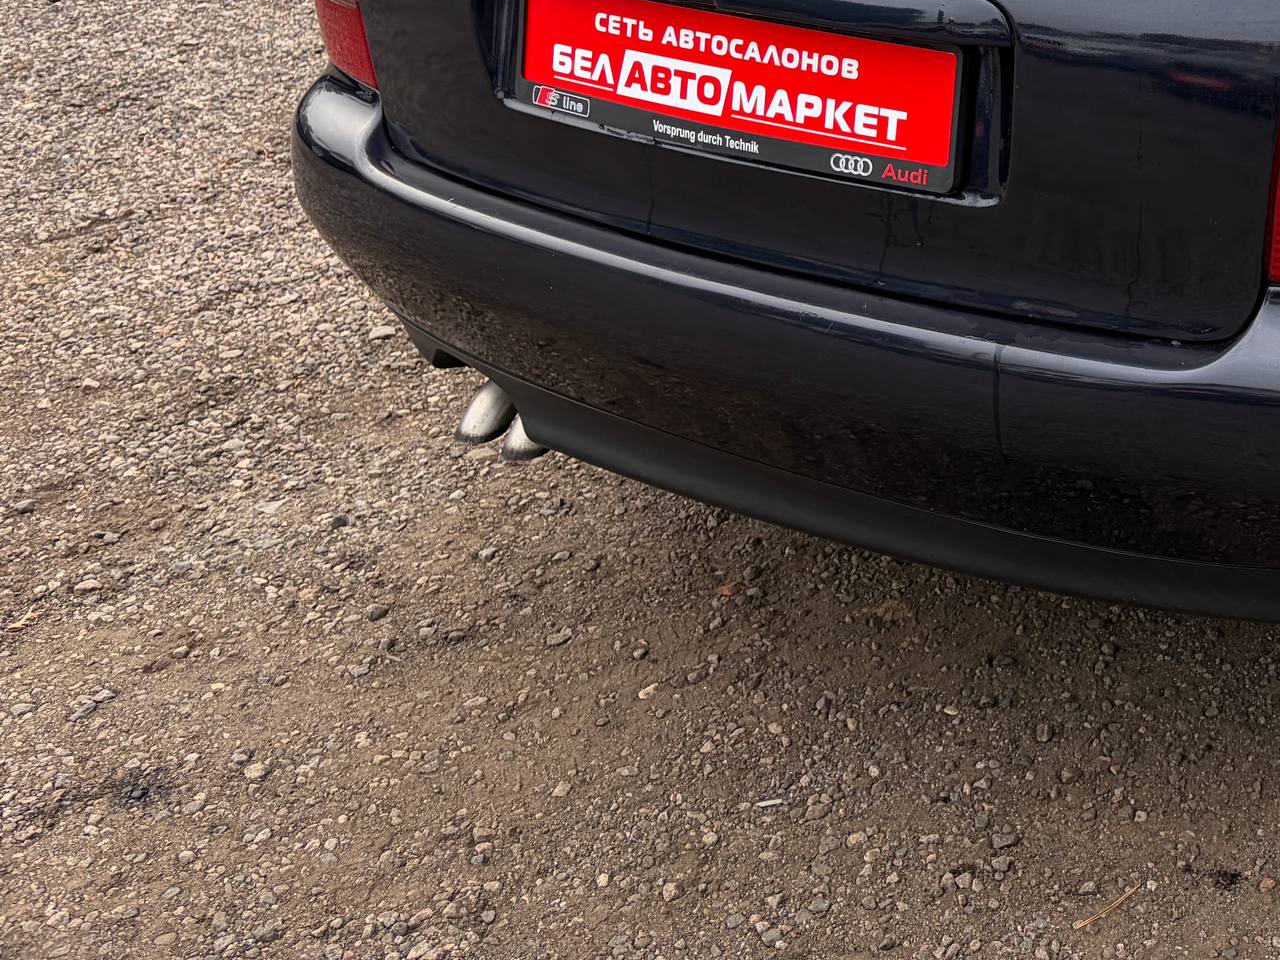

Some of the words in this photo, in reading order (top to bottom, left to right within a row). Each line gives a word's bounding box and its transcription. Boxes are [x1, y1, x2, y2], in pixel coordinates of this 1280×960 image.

[594, 12, 654, 42] СЕТЬ
[661, 25, 860, 80] АВТОСАЛОНОВ
[562, 96, 584, 113] line
[652, 119, 696, 143] Vorsprung
[697, 129, 723, 146] durch
[724, 135, 760, 154] Technik
[880, 163, 929, 186] Audi
